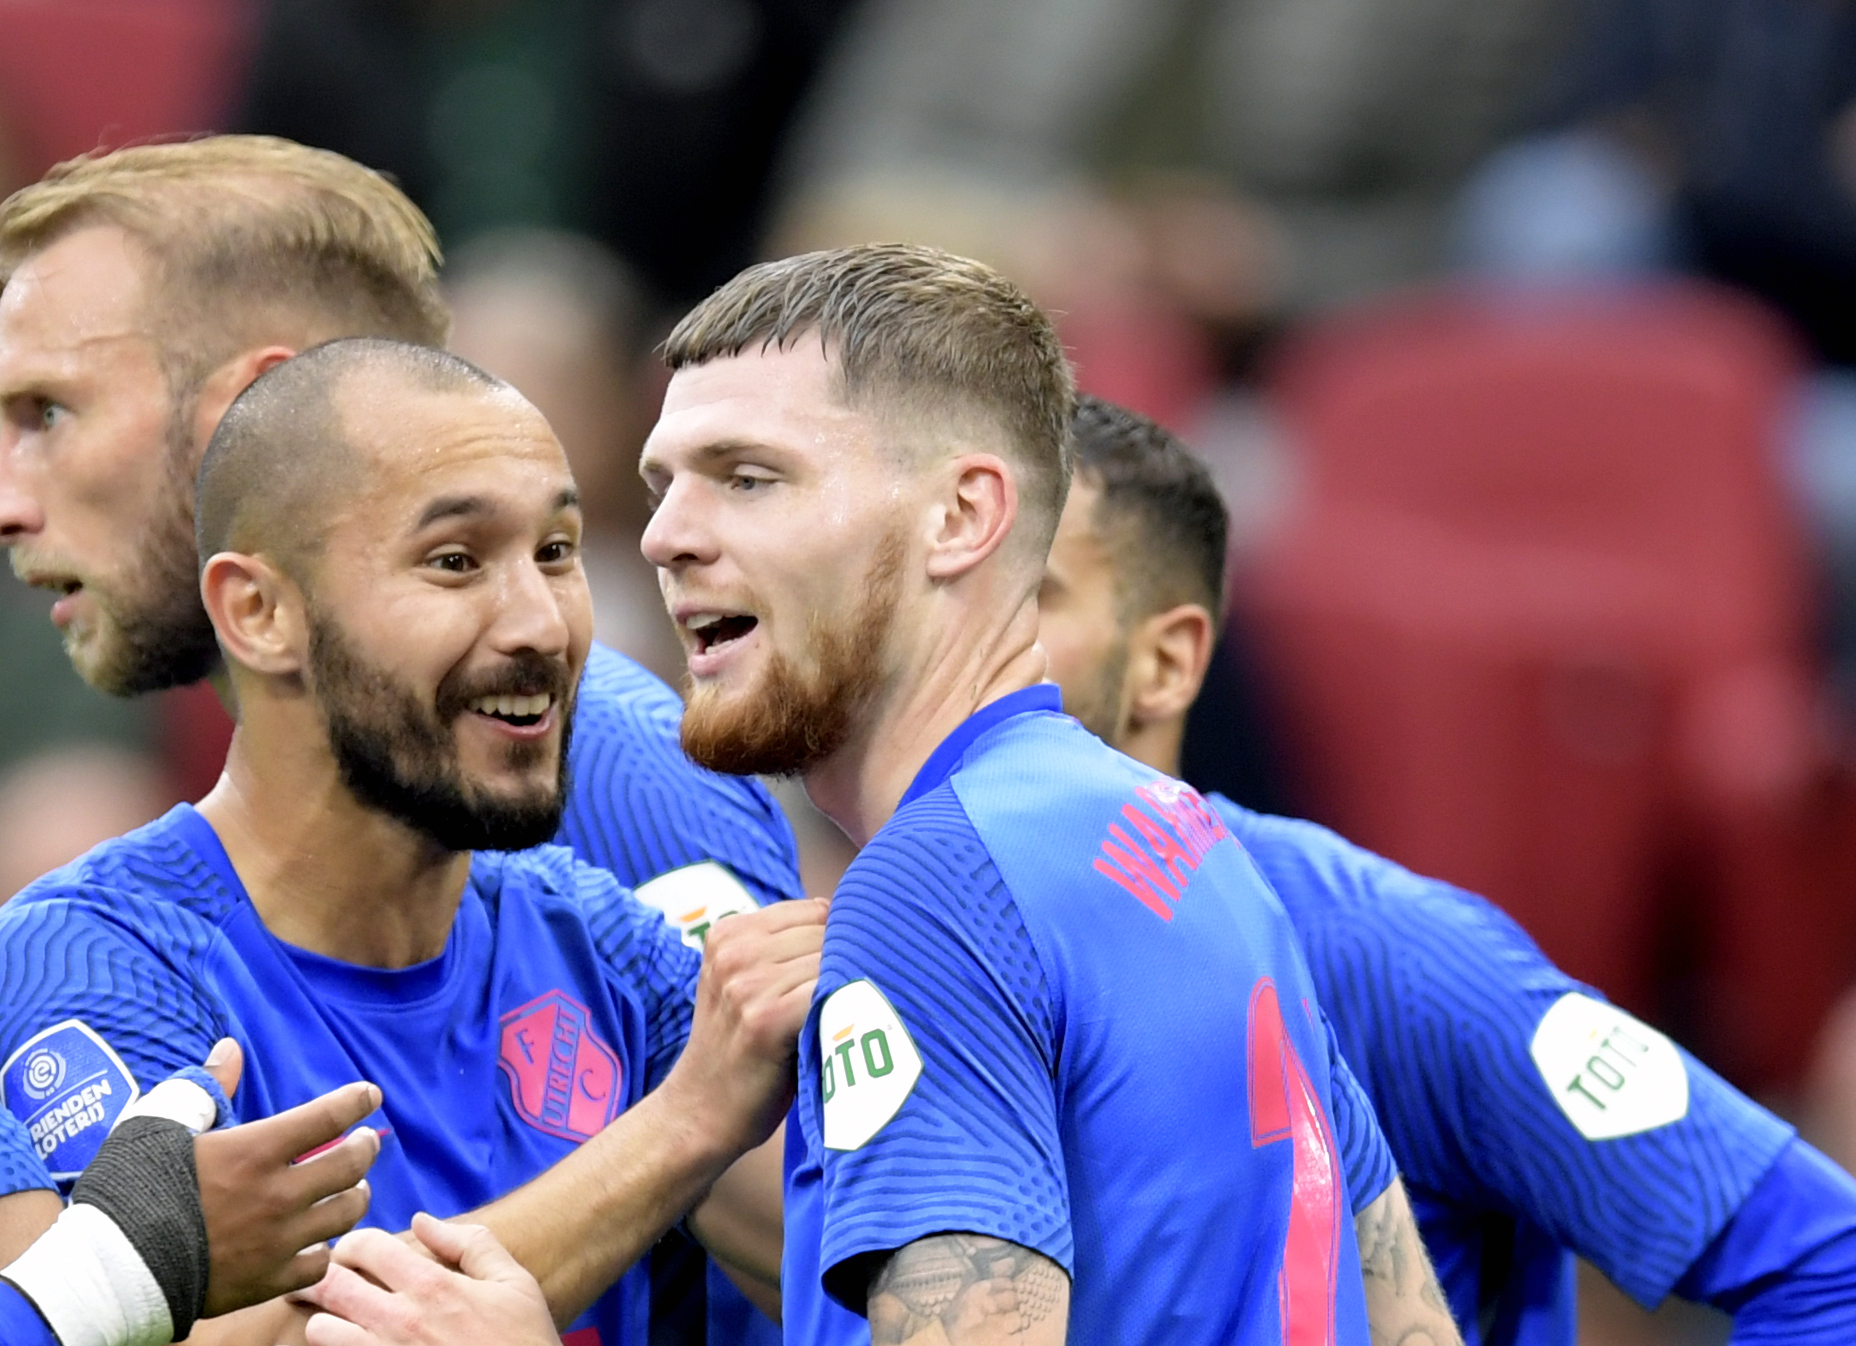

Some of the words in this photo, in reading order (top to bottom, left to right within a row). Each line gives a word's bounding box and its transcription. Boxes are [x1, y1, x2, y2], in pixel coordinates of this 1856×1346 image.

[544, 1007, 578, 1129] UTRECHT
[823, 1027, 895, 1105] OTO
[30, 1078, 113, 1143] RIENDEN
[34, 1101, 106, 1161] LOTERIJ
